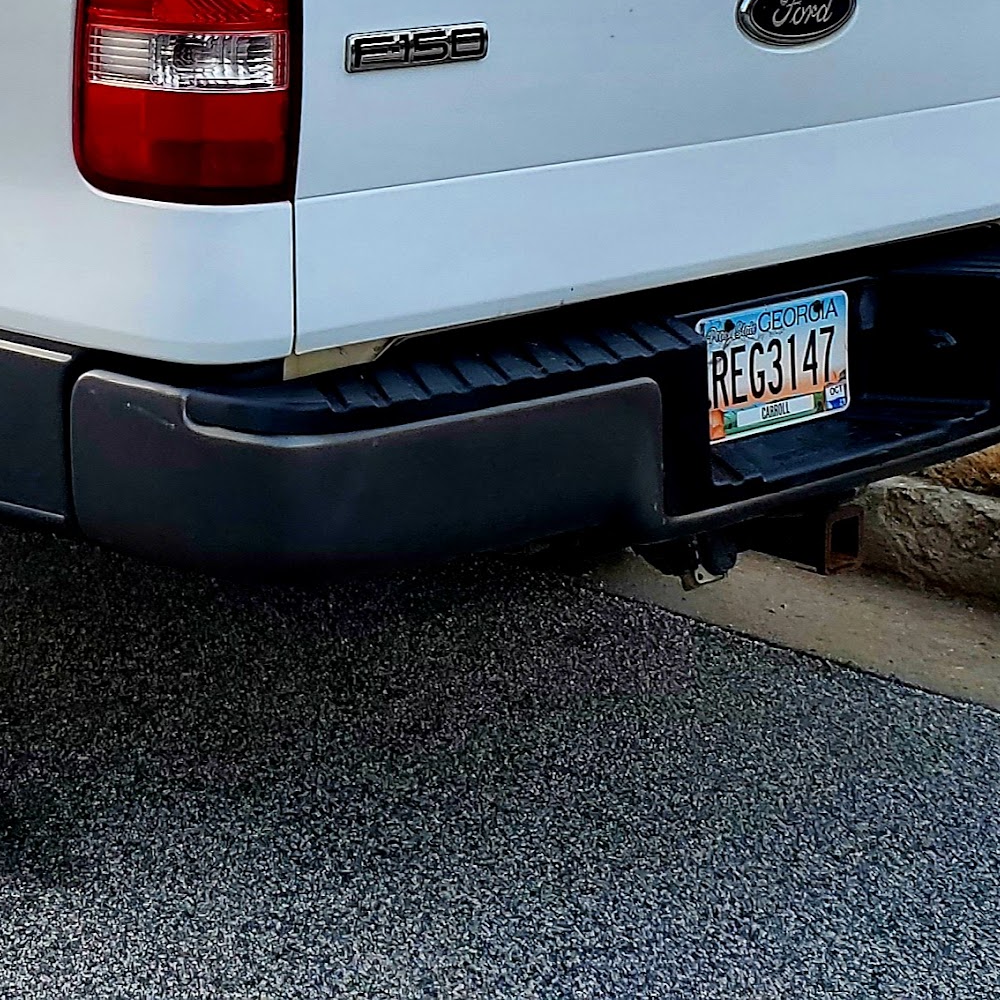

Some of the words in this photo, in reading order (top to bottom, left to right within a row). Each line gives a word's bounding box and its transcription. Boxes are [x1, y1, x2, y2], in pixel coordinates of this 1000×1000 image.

[353, 26, 486, 69] F-150
[758, 298, 839, 333] GEORGIA
[711, 325, 836, 410] REG3147
[829, 384, 843, 396] OCT
[761, 401, 791, 420] CARROLL
